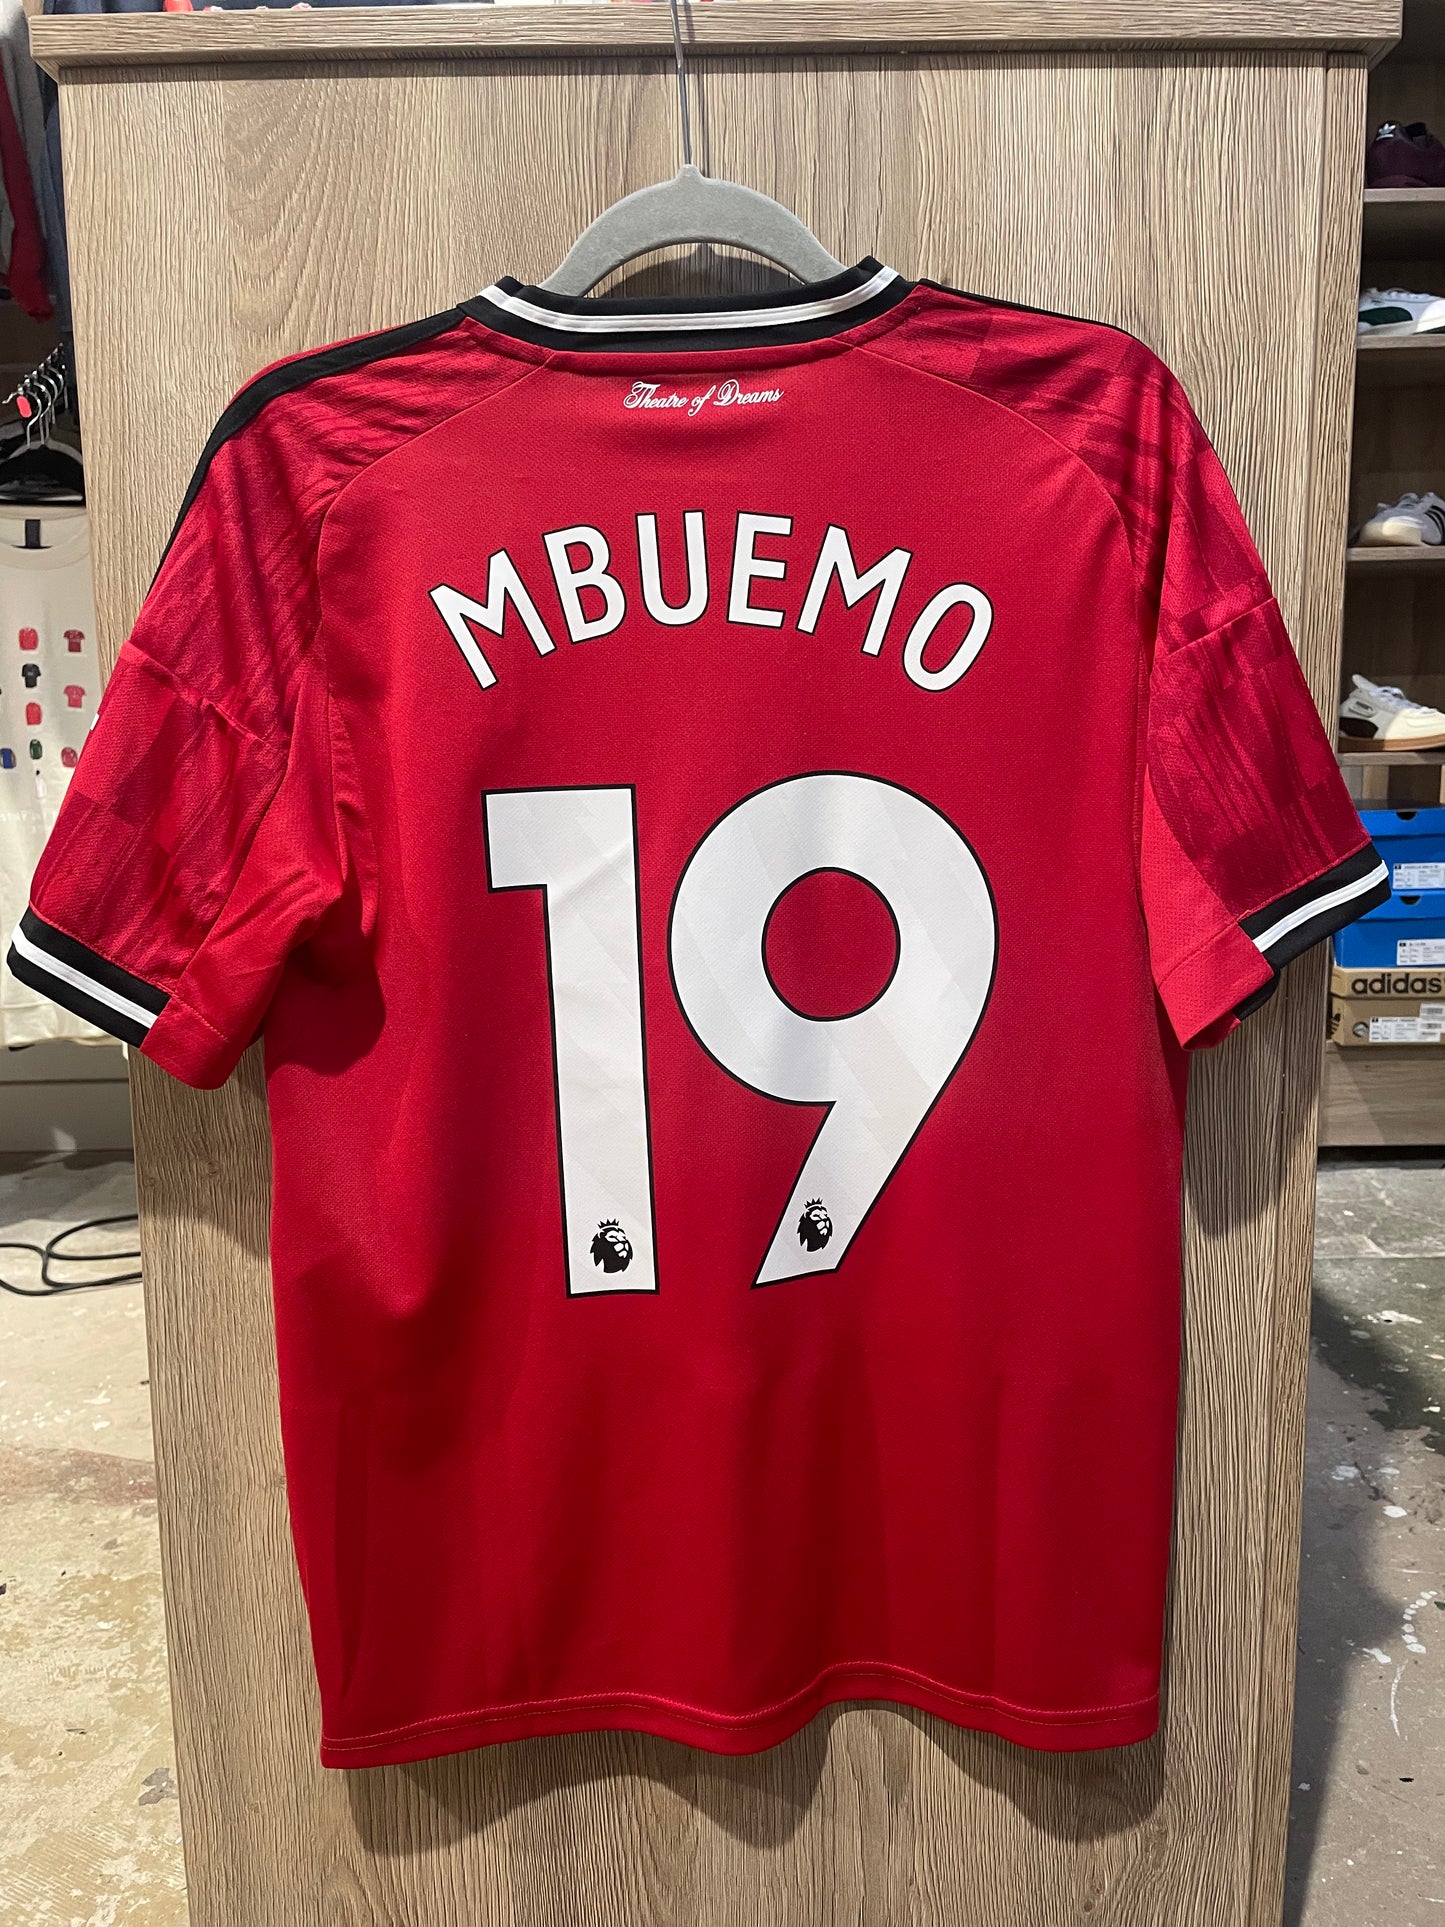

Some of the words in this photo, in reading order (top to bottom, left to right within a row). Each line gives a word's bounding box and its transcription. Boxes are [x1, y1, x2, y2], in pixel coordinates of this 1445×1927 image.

[623, 381, 688, 408] Theatre
[687, 385, 717, 417] of
[713, 379, 784, 406] Dreams
[429, 511, 993, 691] MBUEMO
[482, 770, 998, 1297] 19
[1351, 972, 1442, 994] adidas
